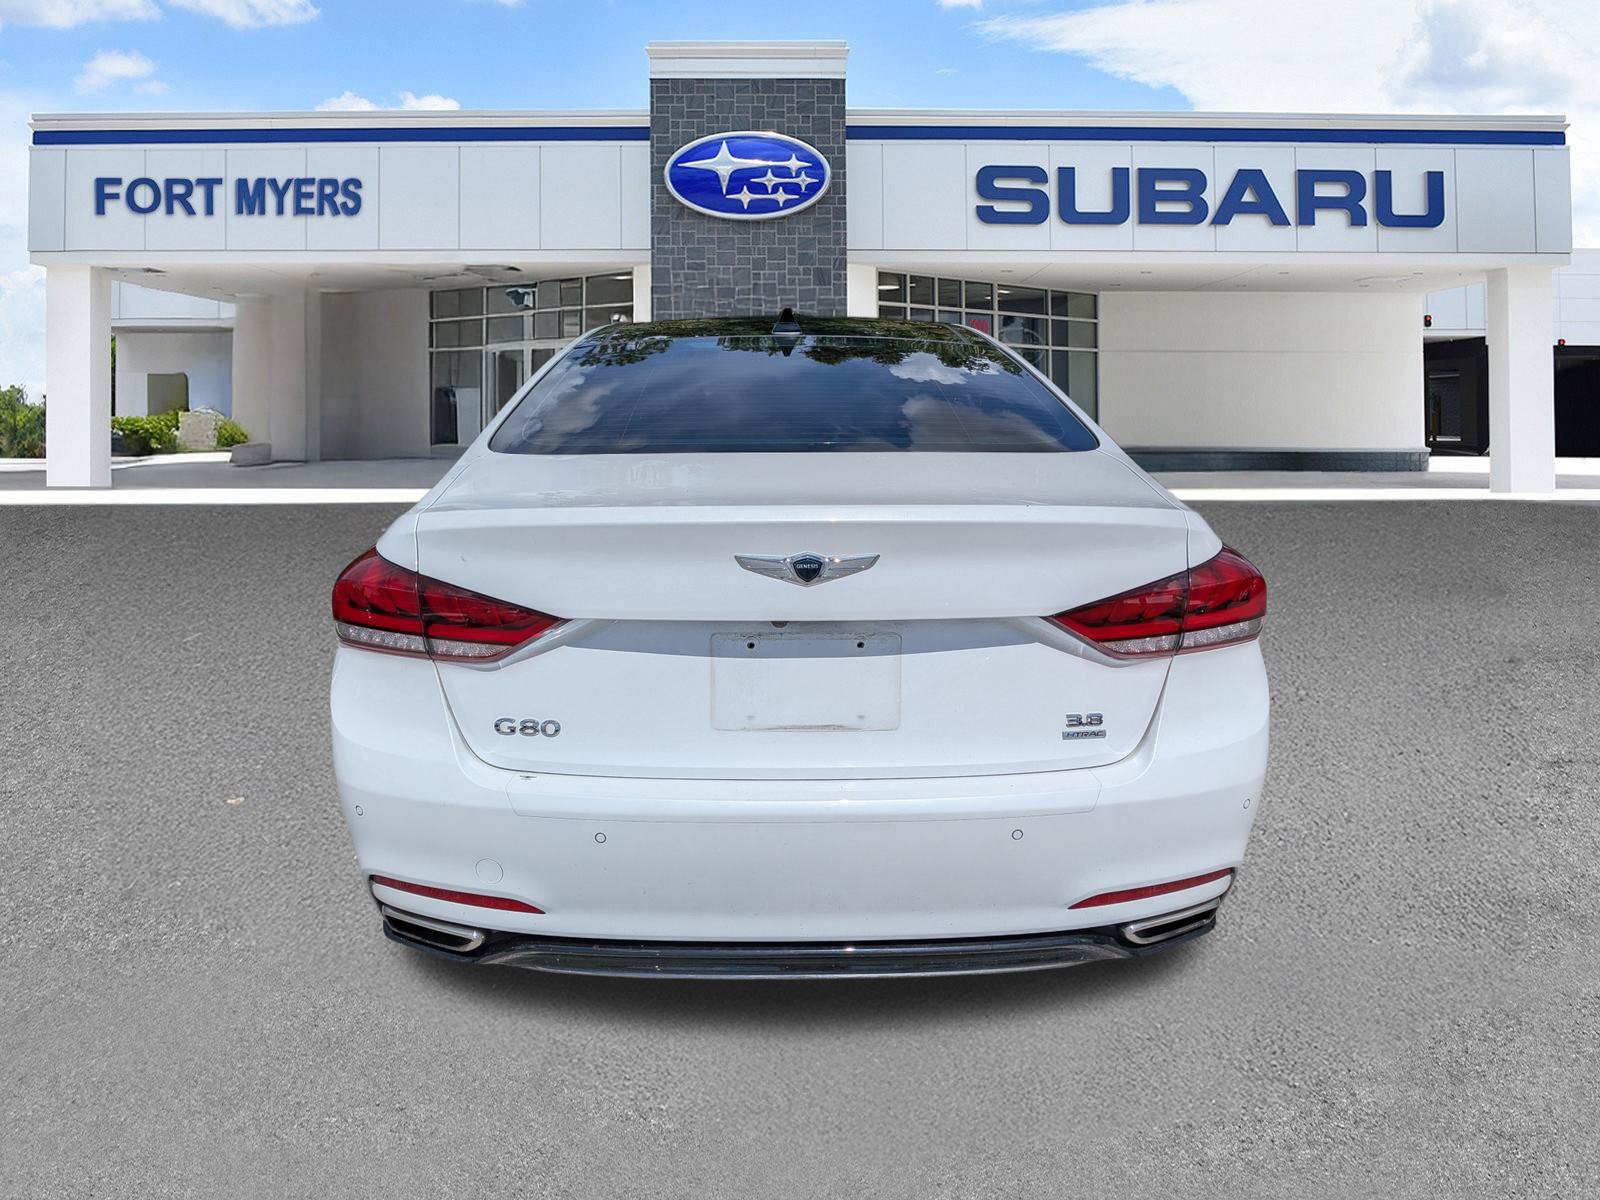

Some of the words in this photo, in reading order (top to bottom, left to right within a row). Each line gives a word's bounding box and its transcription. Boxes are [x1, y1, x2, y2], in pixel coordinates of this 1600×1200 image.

[95, 177, 223, 216] FORT
[235, 177, 363, 217] MYERS
[976, 164, 1445, 229] SUBARU
[494, 717, 561, 738] G80
[1065, 712, 1104, 728] 3.8
[1064, 730, 1105, 738] HTRAC
